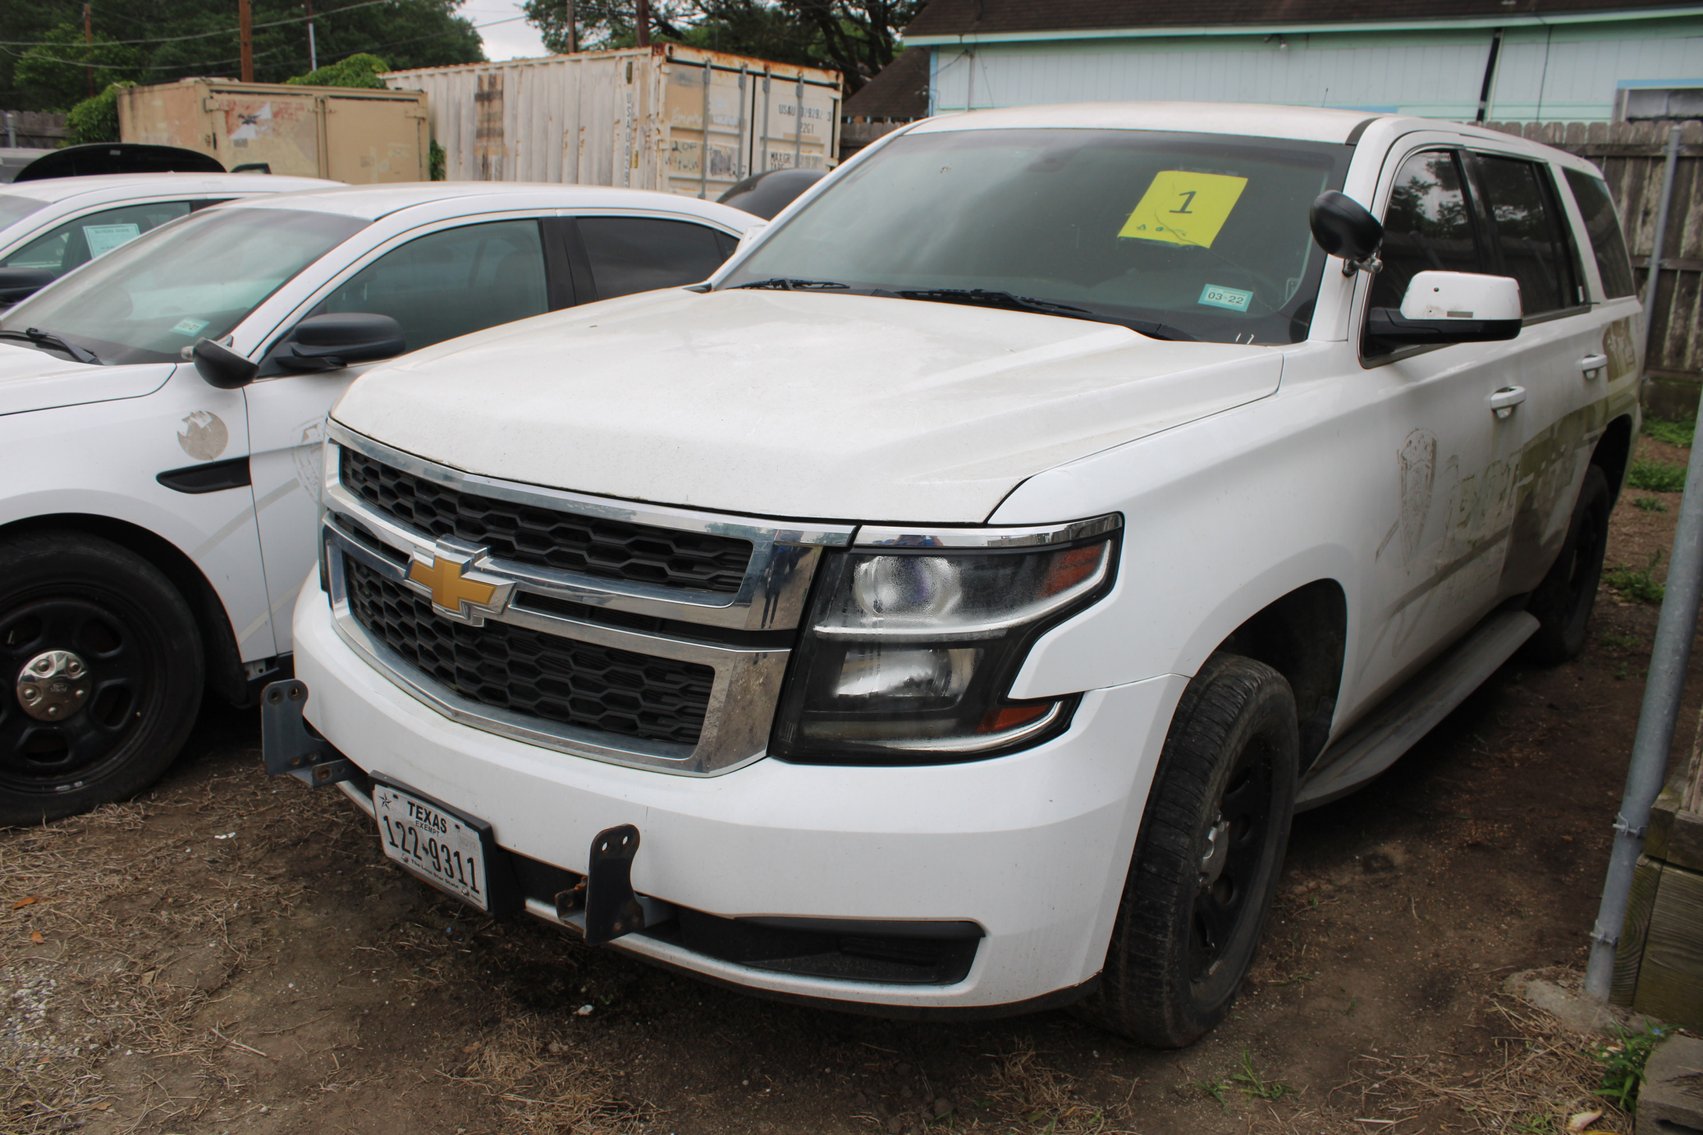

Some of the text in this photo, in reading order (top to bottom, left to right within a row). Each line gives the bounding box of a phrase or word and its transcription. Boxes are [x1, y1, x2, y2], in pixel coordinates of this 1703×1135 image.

[1169, 191, 1197, 214] 1
[407, 801, 447, 833] TEXAS
[415, 821, 440, 837] EXEMPT
